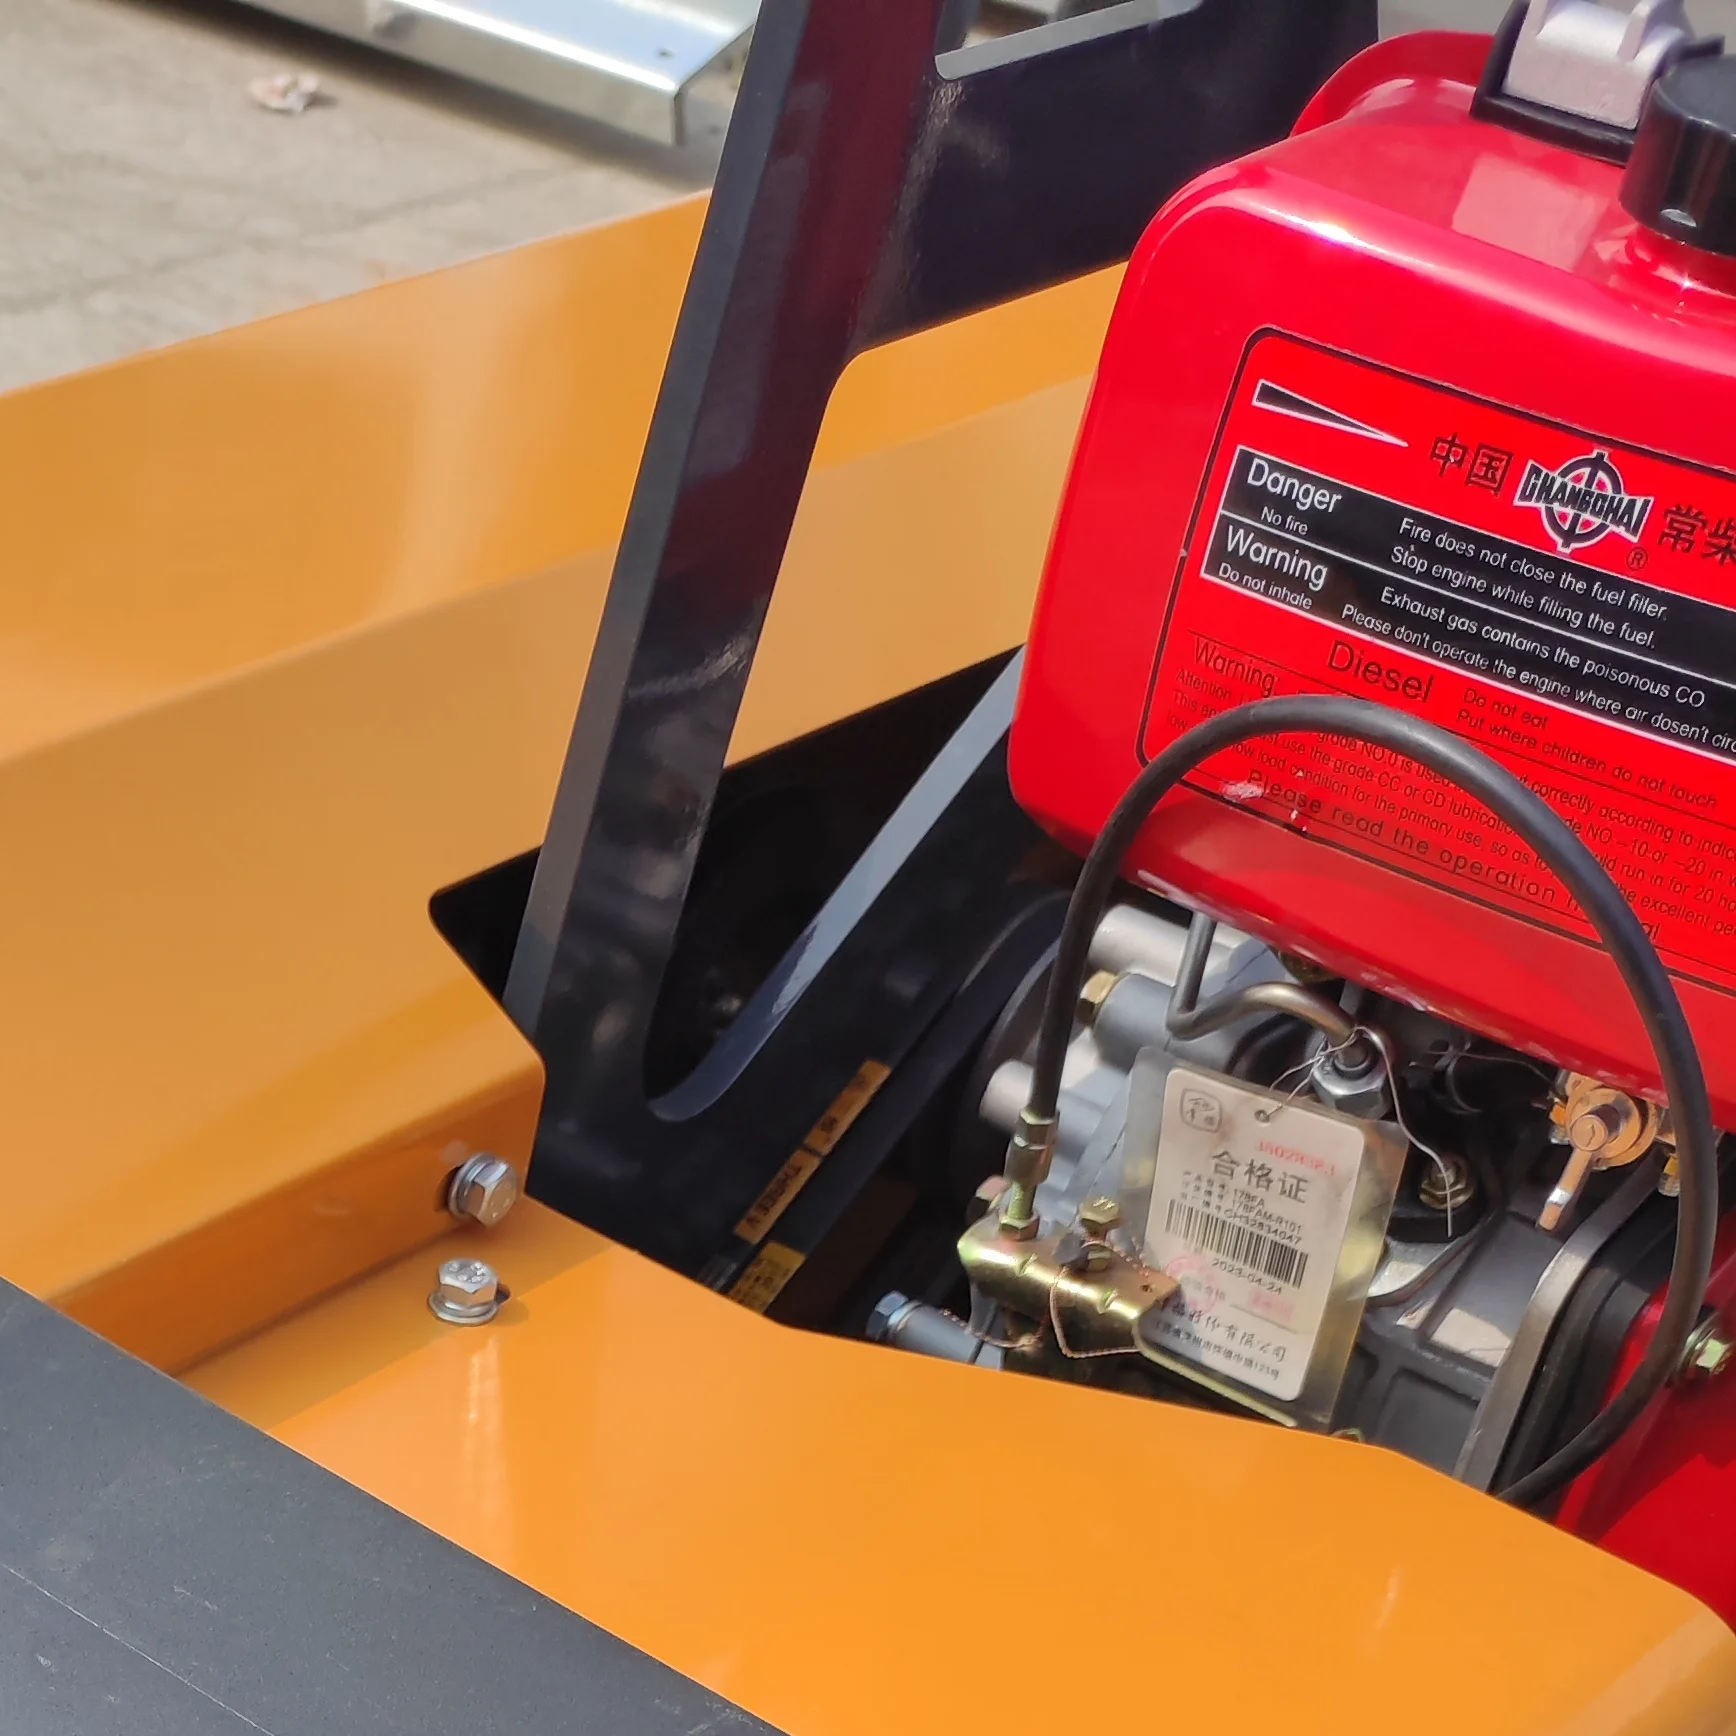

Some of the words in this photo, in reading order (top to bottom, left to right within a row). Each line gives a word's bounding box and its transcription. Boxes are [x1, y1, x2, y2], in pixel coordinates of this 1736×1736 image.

[1247, 457, 1342, 513] Danger
[1429, 432, 1514, 497] 中国
[1261, 505, 1282, 526] No
[1285, 513, 1308, 536] fire
[1218, 561, 1239, 584] Do
[1242, 570, 1266, 594] not
[1267, 580, 1314, 610] inhale
[1227, 524, 1328, 592] Warning
[1399, 517, 1431, 543] Fire
[1434, 528, 1475, 558] does
[1478, 545, 1508, 569] not
[1509, 554, 1555, 585] close
[1559, 570, 1587, 595] the
[1590, 577, 1625, 608] fuel
[1391, 545, 1427, 575] Stop
[1431, 563, 1487, 595] engine
[1491, 582, 1534, 611] while
[1538, 594, 1582, 629] filling
[1587, 606, 1615, 636] the
[1618, 620, 1656, 650] fuel.
[1327, 639, 1435, 704] Diesel
[1341, 603, 1392, 636] Please
[1394, 623, 1431, 649] don't
[1433, 640, 1489, 669] operate
[1492, 658, 1517, 680] the
[1519, 669, 1571, 698] engine
[1574, 682, 1622, 716] where
[1625, 702, 1650, 723] air
[1651, 711, 1710, 744] dosen't
[1381, 585, 1445, 623] Exhaust
[1447, 612, 1478, 635] gas
[1481, 622, 1551, 659] contains
[1553, 642, 1581, 669] the
[1582, 656, 1671, 698] poisonous
[1675, 685, 1706, 709] CO
[1173, 689, 1199, 713] This
[1463, 686, 1488, 708] Do
[1490, 699, 1518, 718] not
[1520, 711, 1550, 731] eat
[1281, 739, 1307, 756] use
[1308, 745, 1332, 766] the
[1333, 758, 1375, 782] grade
[1377, 770, 1402, 792] CC
[1403, 784, 1421, 800] or
[1422, 788, 1446, 808] CD
[1456, 708, 1485, 730] Put
[1489, 722, 1539, 750] where
[1542, 736, 1607, 773] children
[1611, 764, 1633, 783] do
[1637, 772, 1666, 795] not
[1669, 783, 1718, 810] touch
[1248, 768, 1323, 815] Please
[1331, 806, 1385, 838] read
[1392, 827, 1430, 857] the
[1438, 848, 1556, 904] operation
[1257, 748, 1287, 771] load
[1288, 764, 1349, 797] condition
[1352, 784, 1373, 804] for
[1374, 793, 1397, 814] the
[1397, 806, 1454, 839] primary
[1489, 840, 1509, 857] so
[1511, 849, 1531, 866] as
[1531, 781, 1596, 815] correctly
[1599, 804, 1674, 843] according
[1677, 828, 1694, 847] to
[1697, 838, 1736, 862] indic
[1620, 863, 1646, 881] run
[1649, 873, 1665, 888] in
[1668, 876, 1691, 896] for
[1692, 884, 1715, 904] 20
[1651, 849, 1669, 864] or
[1708, 869, 1724, 881] in
[1639, 896, 1711, 930] excellent
[1210, 1148, 1312, 1205] 合格证
